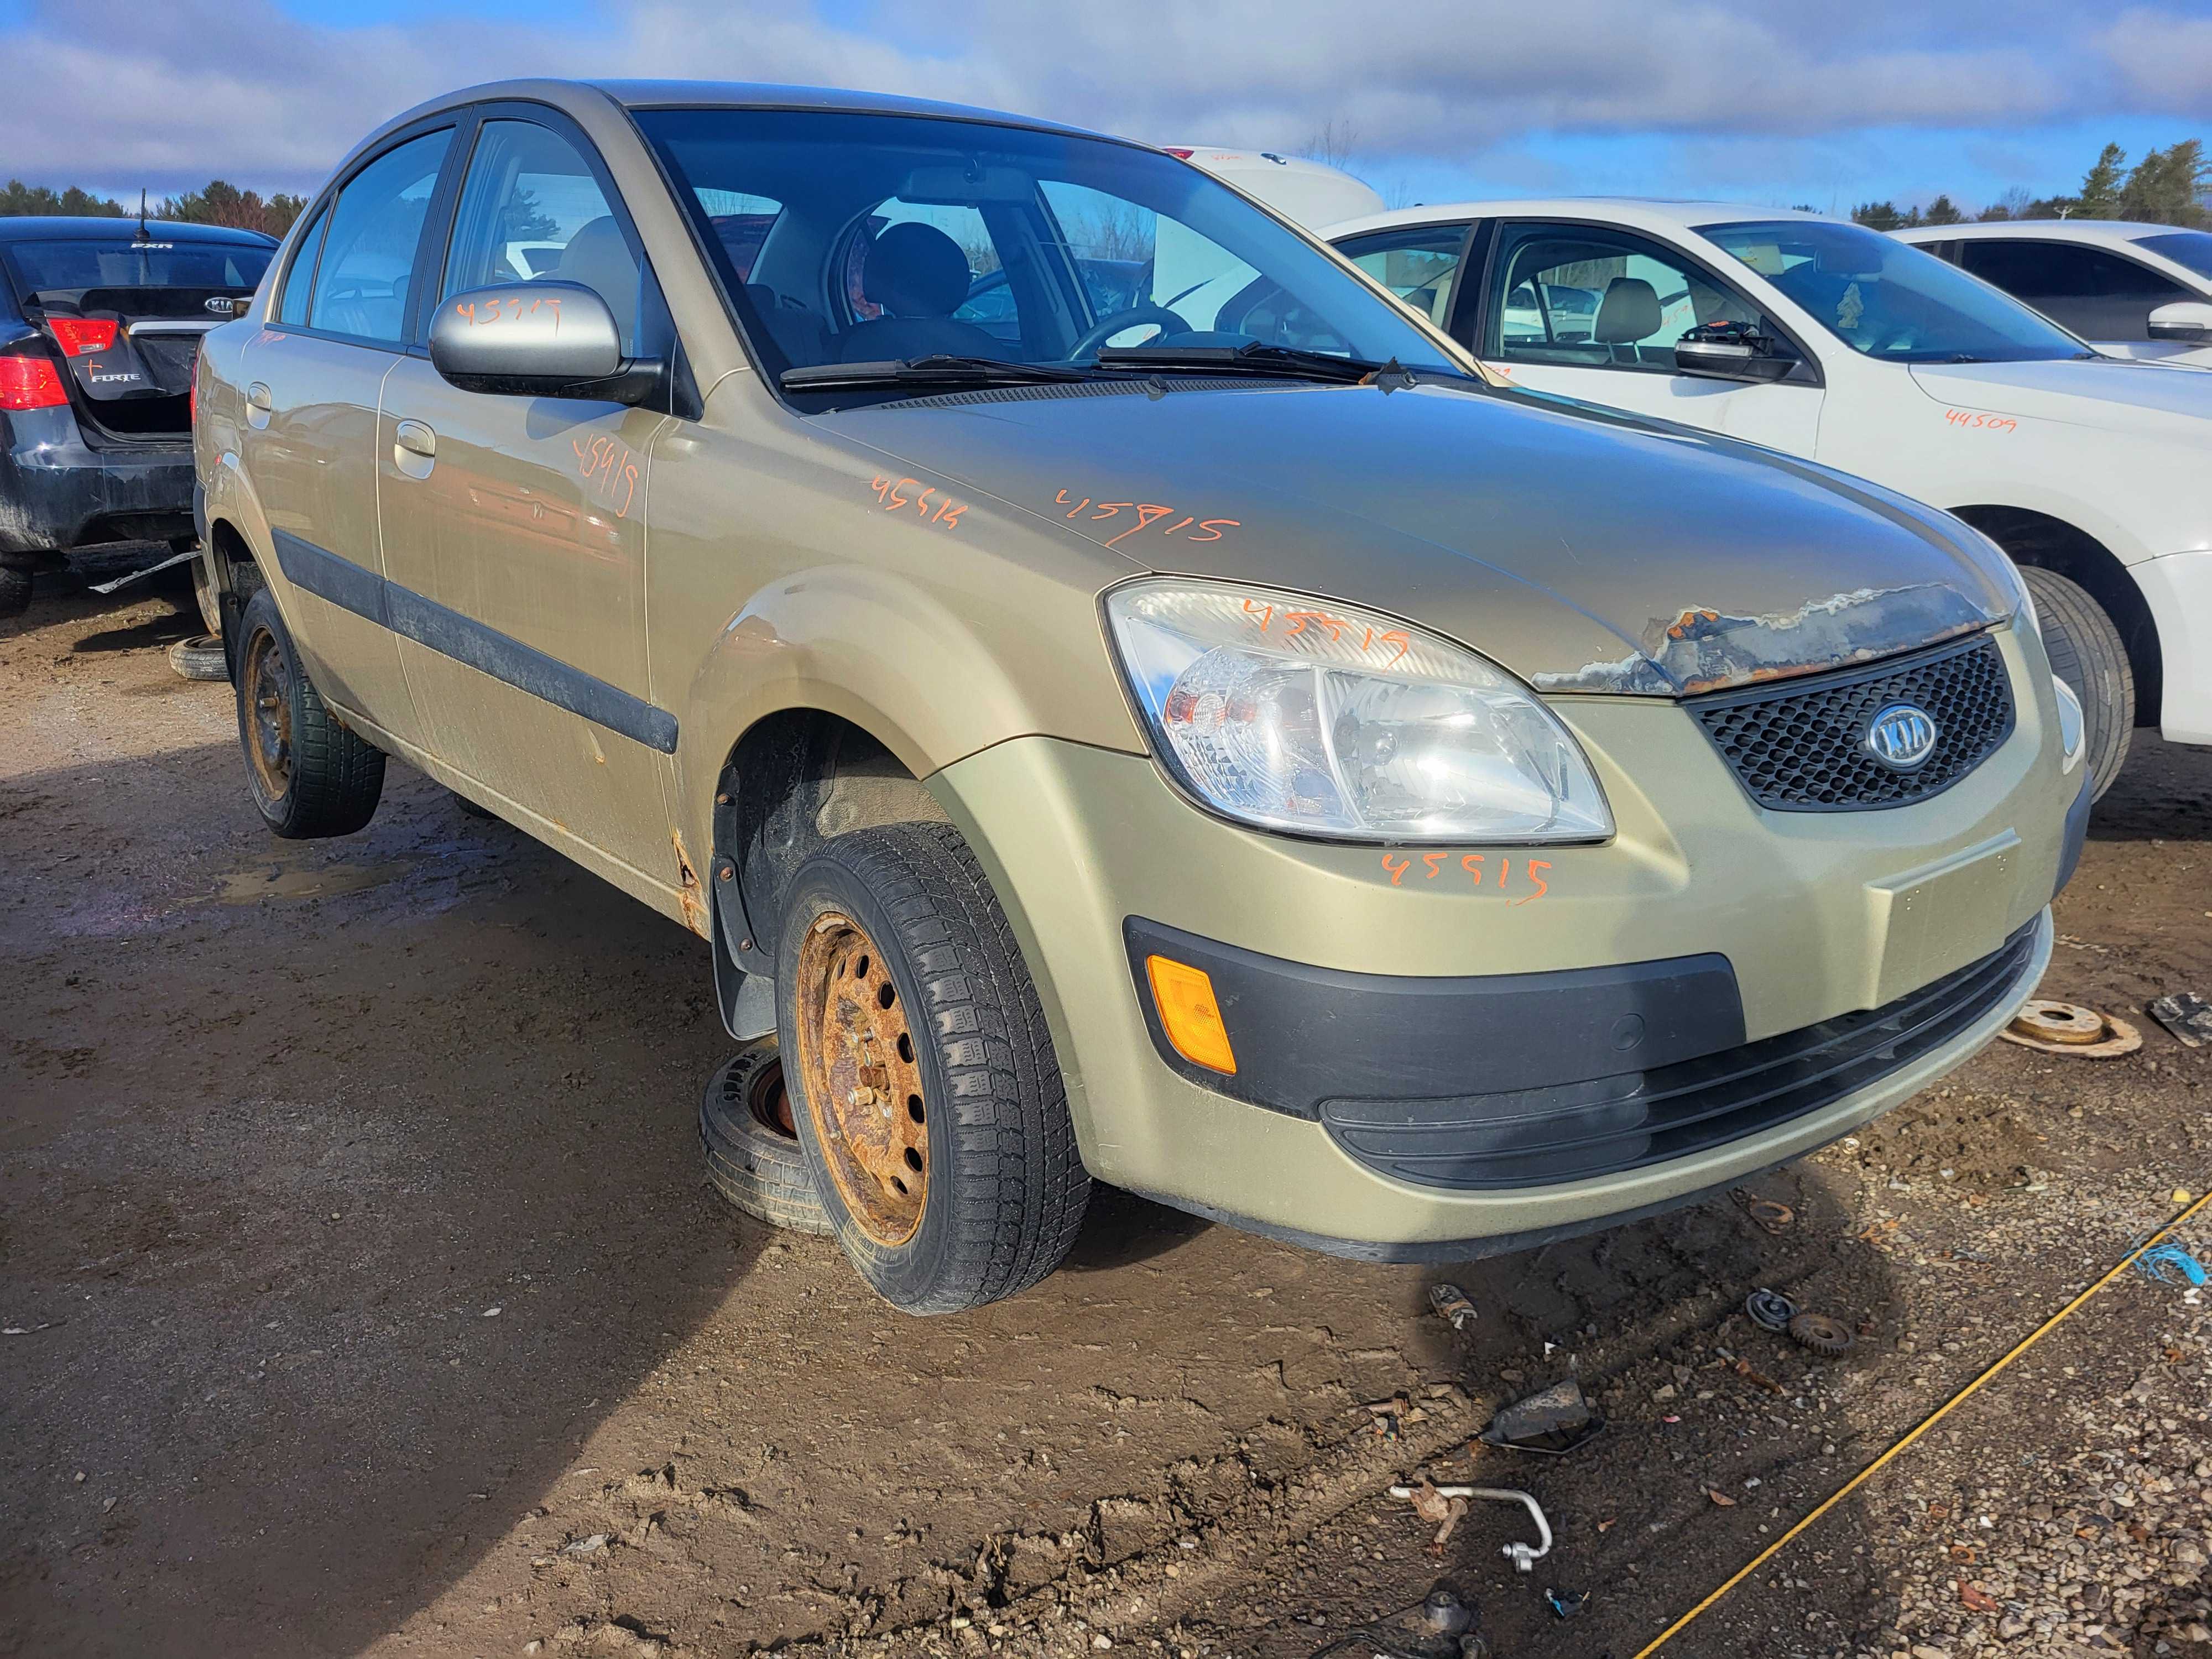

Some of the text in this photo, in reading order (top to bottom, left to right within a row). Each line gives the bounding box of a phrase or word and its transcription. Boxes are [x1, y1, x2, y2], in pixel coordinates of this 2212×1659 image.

[92, 373, 142, 383] FORTE
[1945, 409, 2017, 434] 44509
[1055, 489, 1240, 547] 45915
[1879, 716, 1928, 759] KIA
